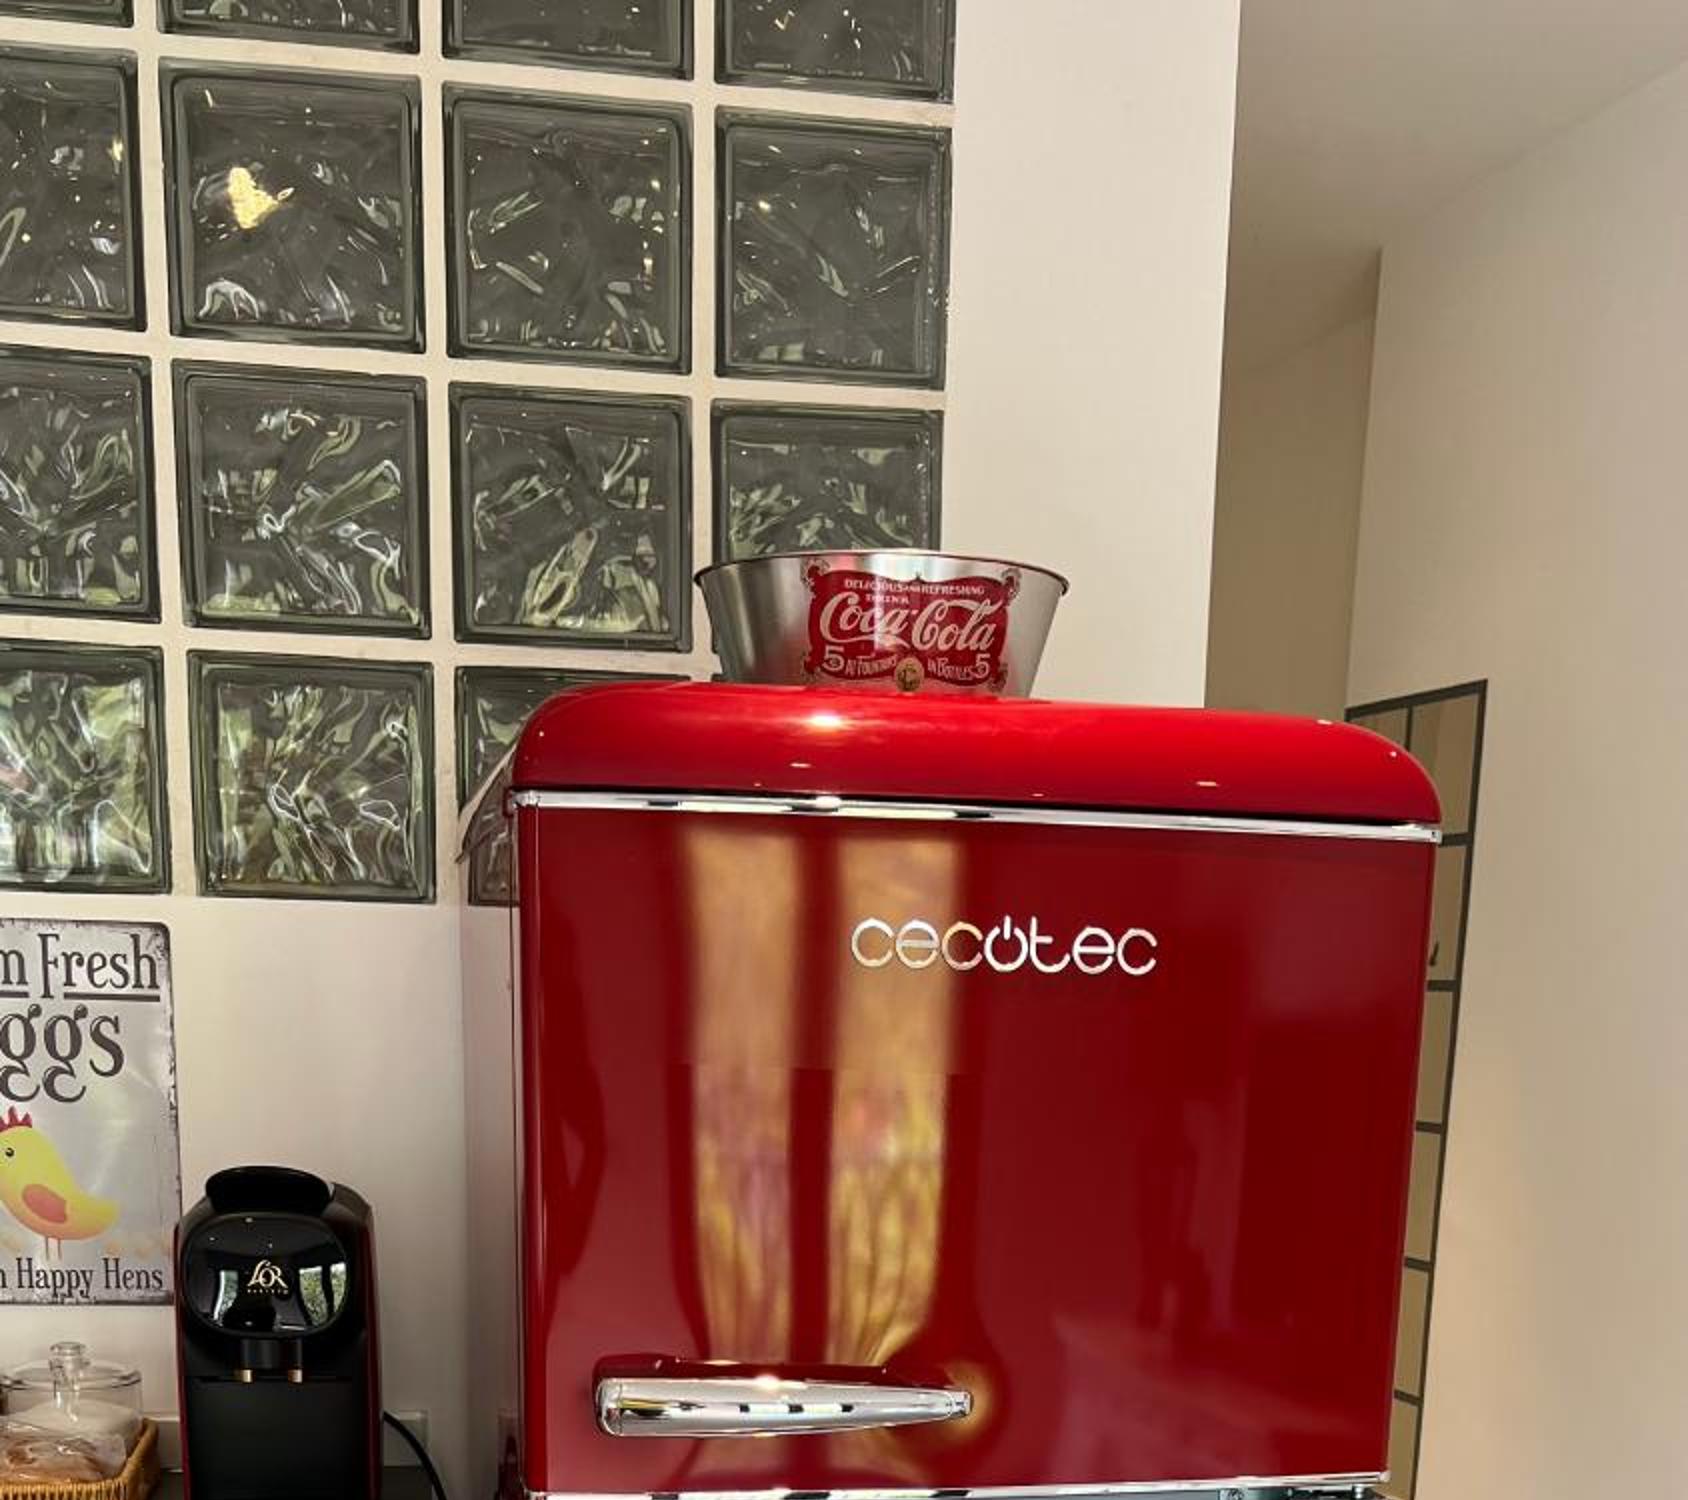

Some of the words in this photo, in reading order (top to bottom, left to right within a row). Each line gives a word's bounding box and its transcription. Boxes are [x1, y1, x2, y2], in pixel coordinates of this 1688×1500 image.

[844, 578, 903, 593] DELICIOUS
[819, 591, 1003, 651] Coca-Cola
[37, 933, 161, 999] Fresh
[851, 915, 1157, 975] cecotec
[0, 1003, 125, 1102] ggs
[16, 1257, 95, 1298] Happy
[102, 1257, 164, 1290] Hens
